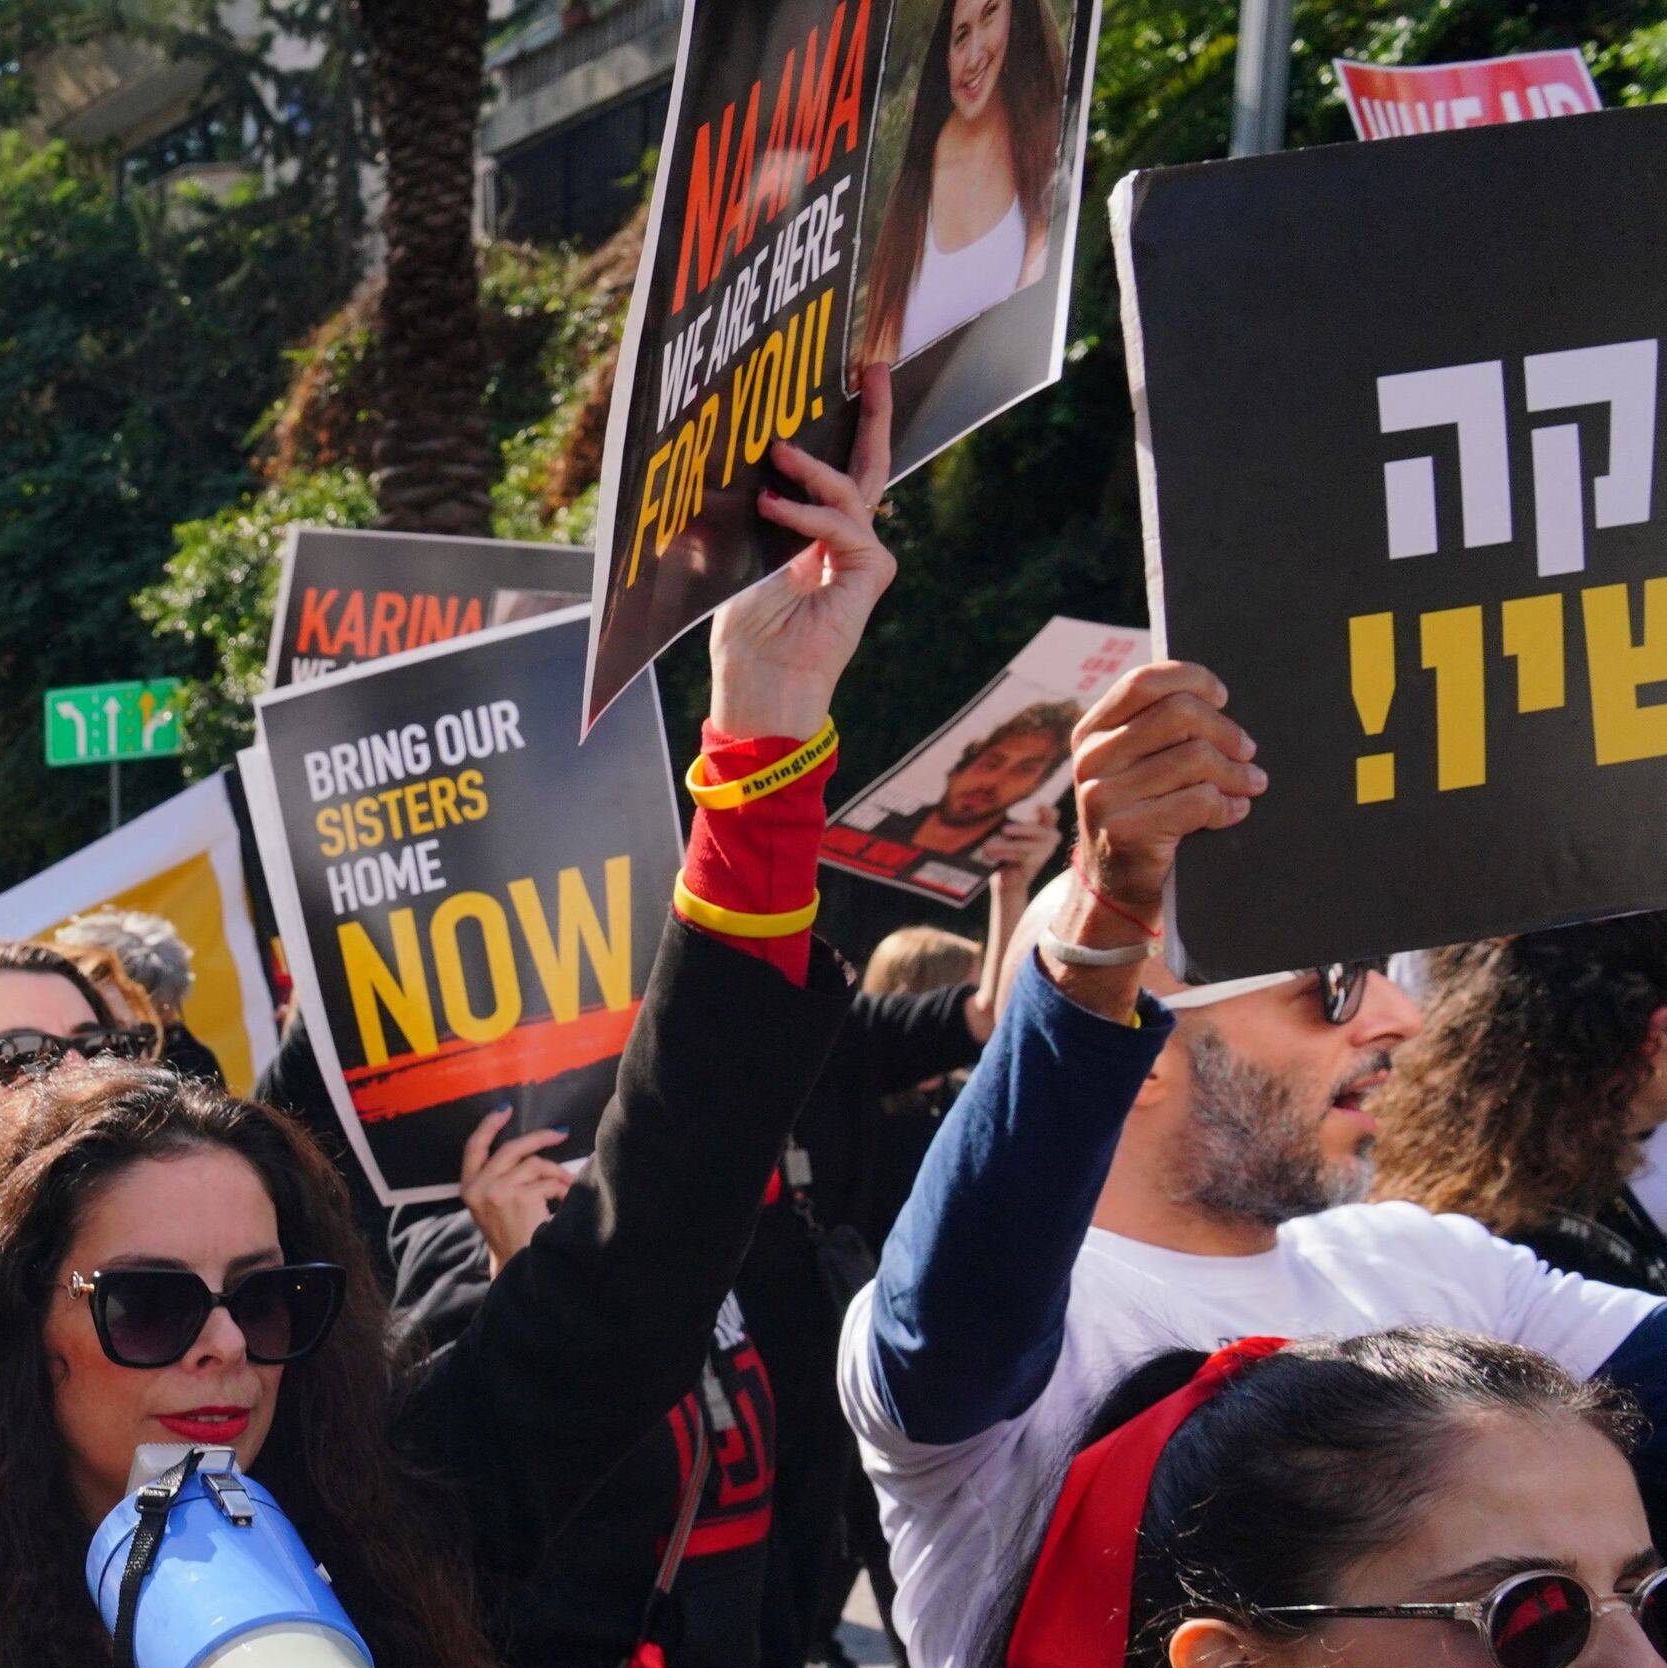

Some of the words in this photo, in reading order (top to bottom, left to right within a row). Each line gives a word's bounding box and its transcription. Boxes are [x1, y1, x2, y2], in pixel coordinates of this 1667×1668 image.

[672, 0, 869, 314] NAAMA
[656, 324, 710, 433] WE
[706, 243, 768, 378] ARE
[763, 174, 851, 324] HERE
[626, 392, 720, 589] FOR
[720, 287, 833, 489] YOU!
[296, 587, 482, 657] KARINA
[303, 722, 427, 803] BRING
[436, 700, 525, 766] OUR
[315, 770, 489, 858] SISTERS
[326, 841, 447, 916] HOME
[336, 855, 631, 1069] NOW
